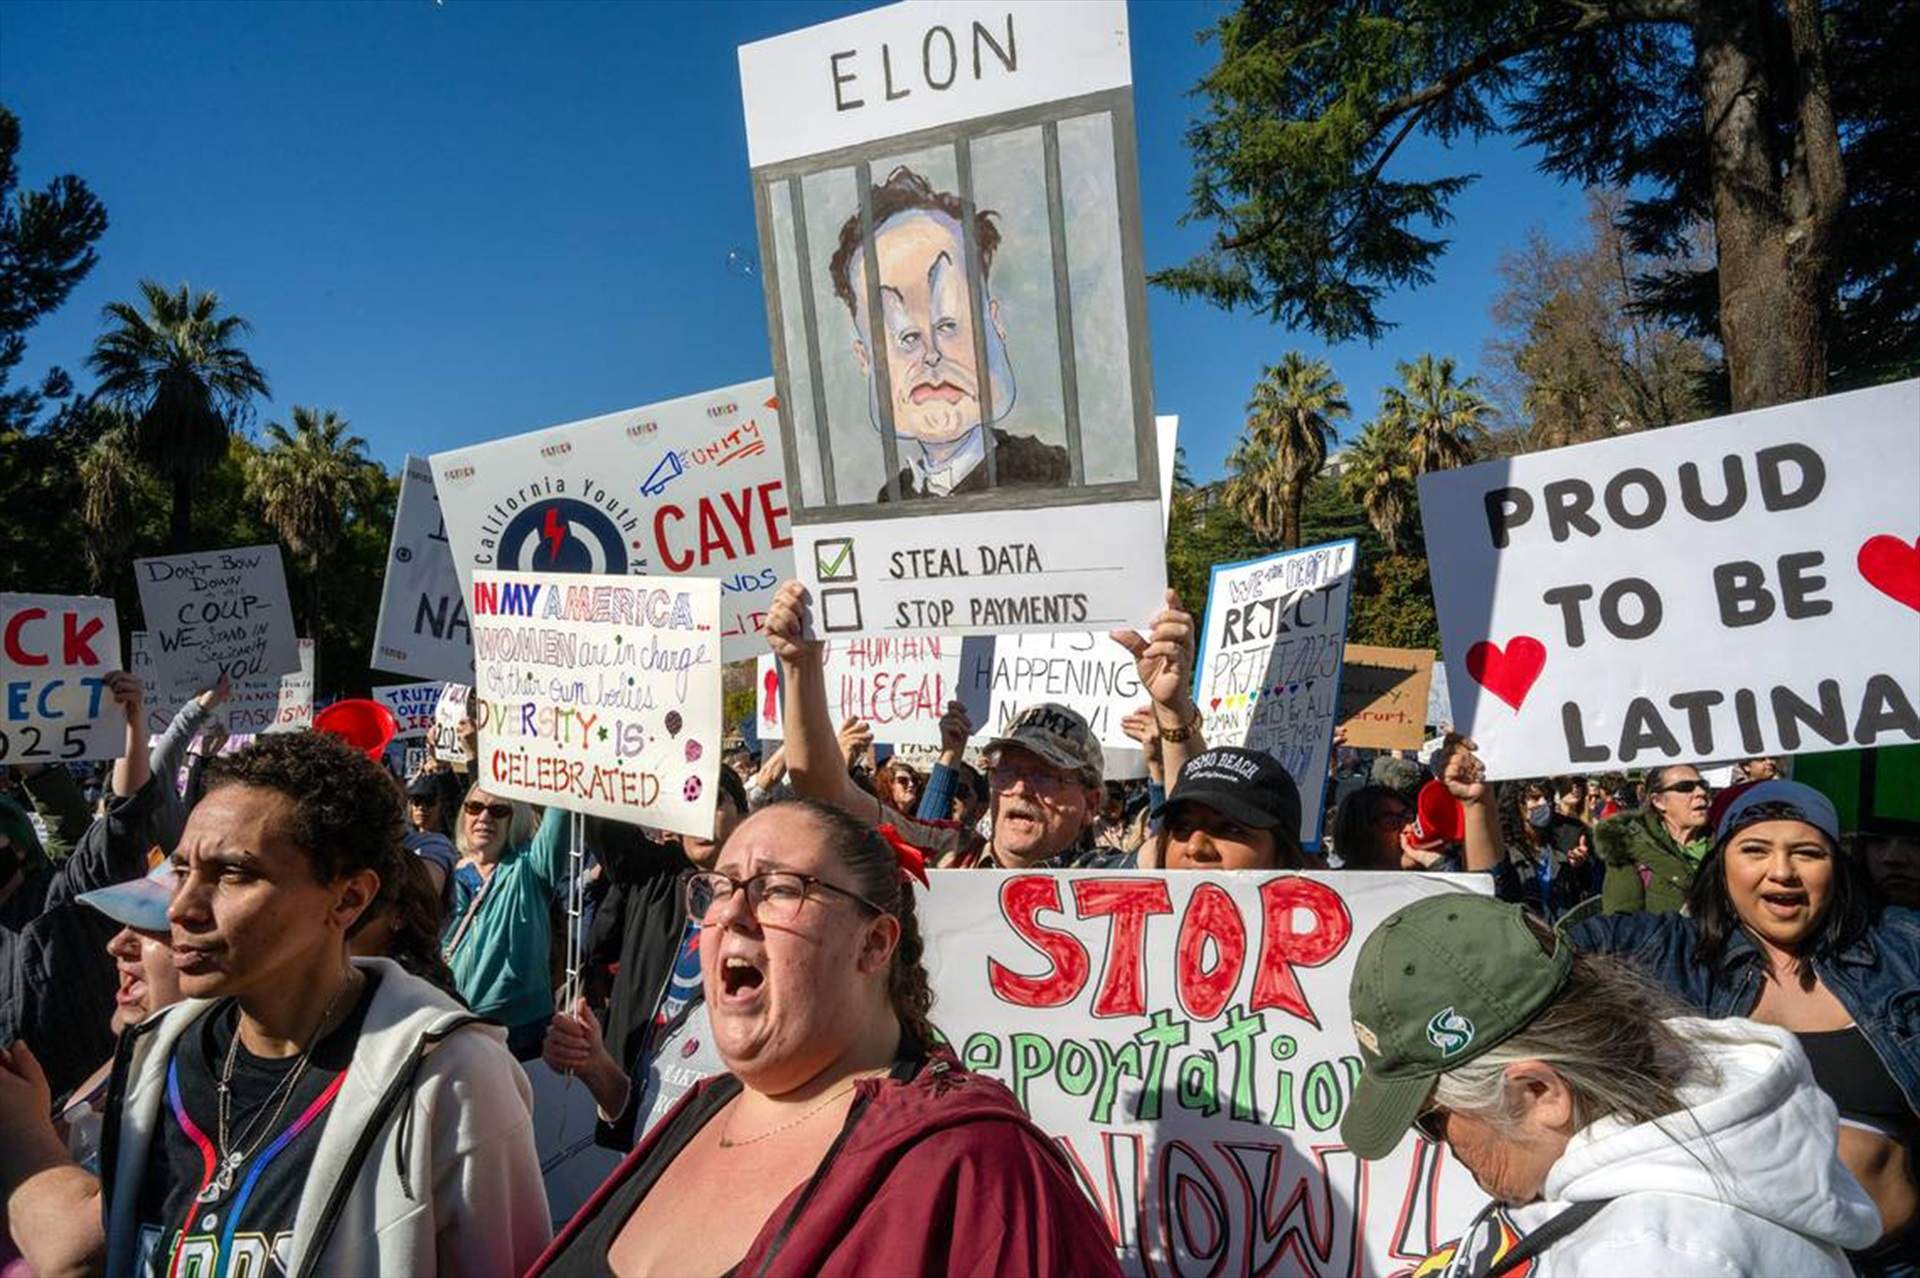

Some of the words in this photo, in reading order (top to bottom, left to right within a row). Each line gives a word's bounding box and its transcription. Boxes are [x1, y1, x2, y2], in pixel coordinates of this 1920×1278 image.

[830, 12, 1017, 112] ELON
[690, 418, 760, 466] UNITY
[473, 476, 566, 566] California
[582, 476, 639, 534] Youth
[1483, 441, 1827, 551] PROUD
[888, 548, 970, 580] STEAL
[978, 543, 1043, 575] DATA
[474, 582, 497, 616] IN
[499, 582, 541, 618] MY
[895, 599, 954, 628] STOP
[970, 592, 1088, 625] PAYMENTS
[1220, 581, 1343, 650] REJECT
[1543, 576, 1664, 648] TO
[1713, 550, 1834, 629] BE
[159, 627, 202, 653] WE
[474, 626, 578, 670] WOMEN
[578, 640, 611, 668] are
[614, 633, 640, 669] in
[641, 634, 712, 704] charge
[386, 687, 444, 704] TRUTH
[840, 672, 944, 724] ILLEGAL
[974, 657, 1141, 698] HAPPENING
[228, 704, 311, 731] FASCISM
[615, 718, 645, 758] IS
[1010, 708, 1077, 739] ARMY
[1561, 673, 1920, 765] LATINA
[491, 748, 661, 808] CELEBRATED
[1216, 752, 1260, 780] BEACH
[987, 873, 1354, 1031] STOP
[950, 1006, 1368, 1132] eportatio
